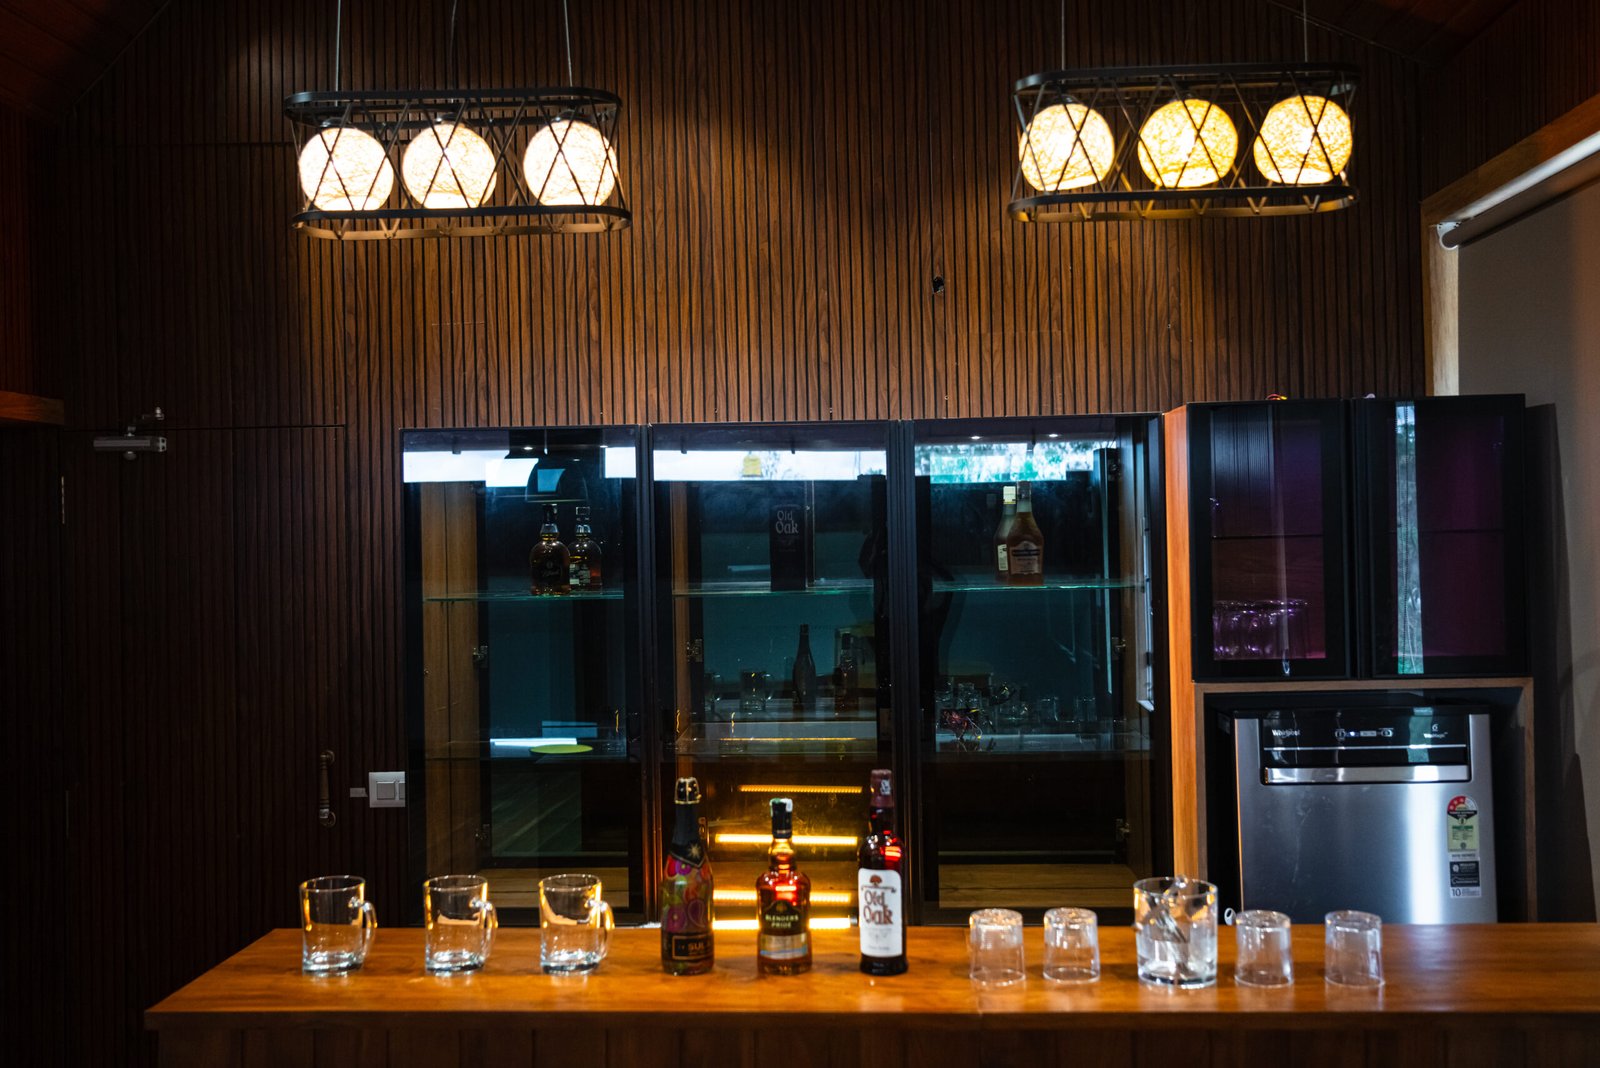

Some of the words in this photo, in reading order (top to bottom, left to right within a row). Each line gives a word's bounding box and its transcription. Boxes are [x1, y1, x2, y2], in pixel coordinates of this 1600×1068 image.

[777, 510, 793, 521] Old
[775, 520, 799, 534] Oak
[864, 889, 885, 906] Old
[765, 914, 799, 922] BLENDERS
[863, 905, 893, 924] Oak
[771, 921, 792, 929] PRIDE
